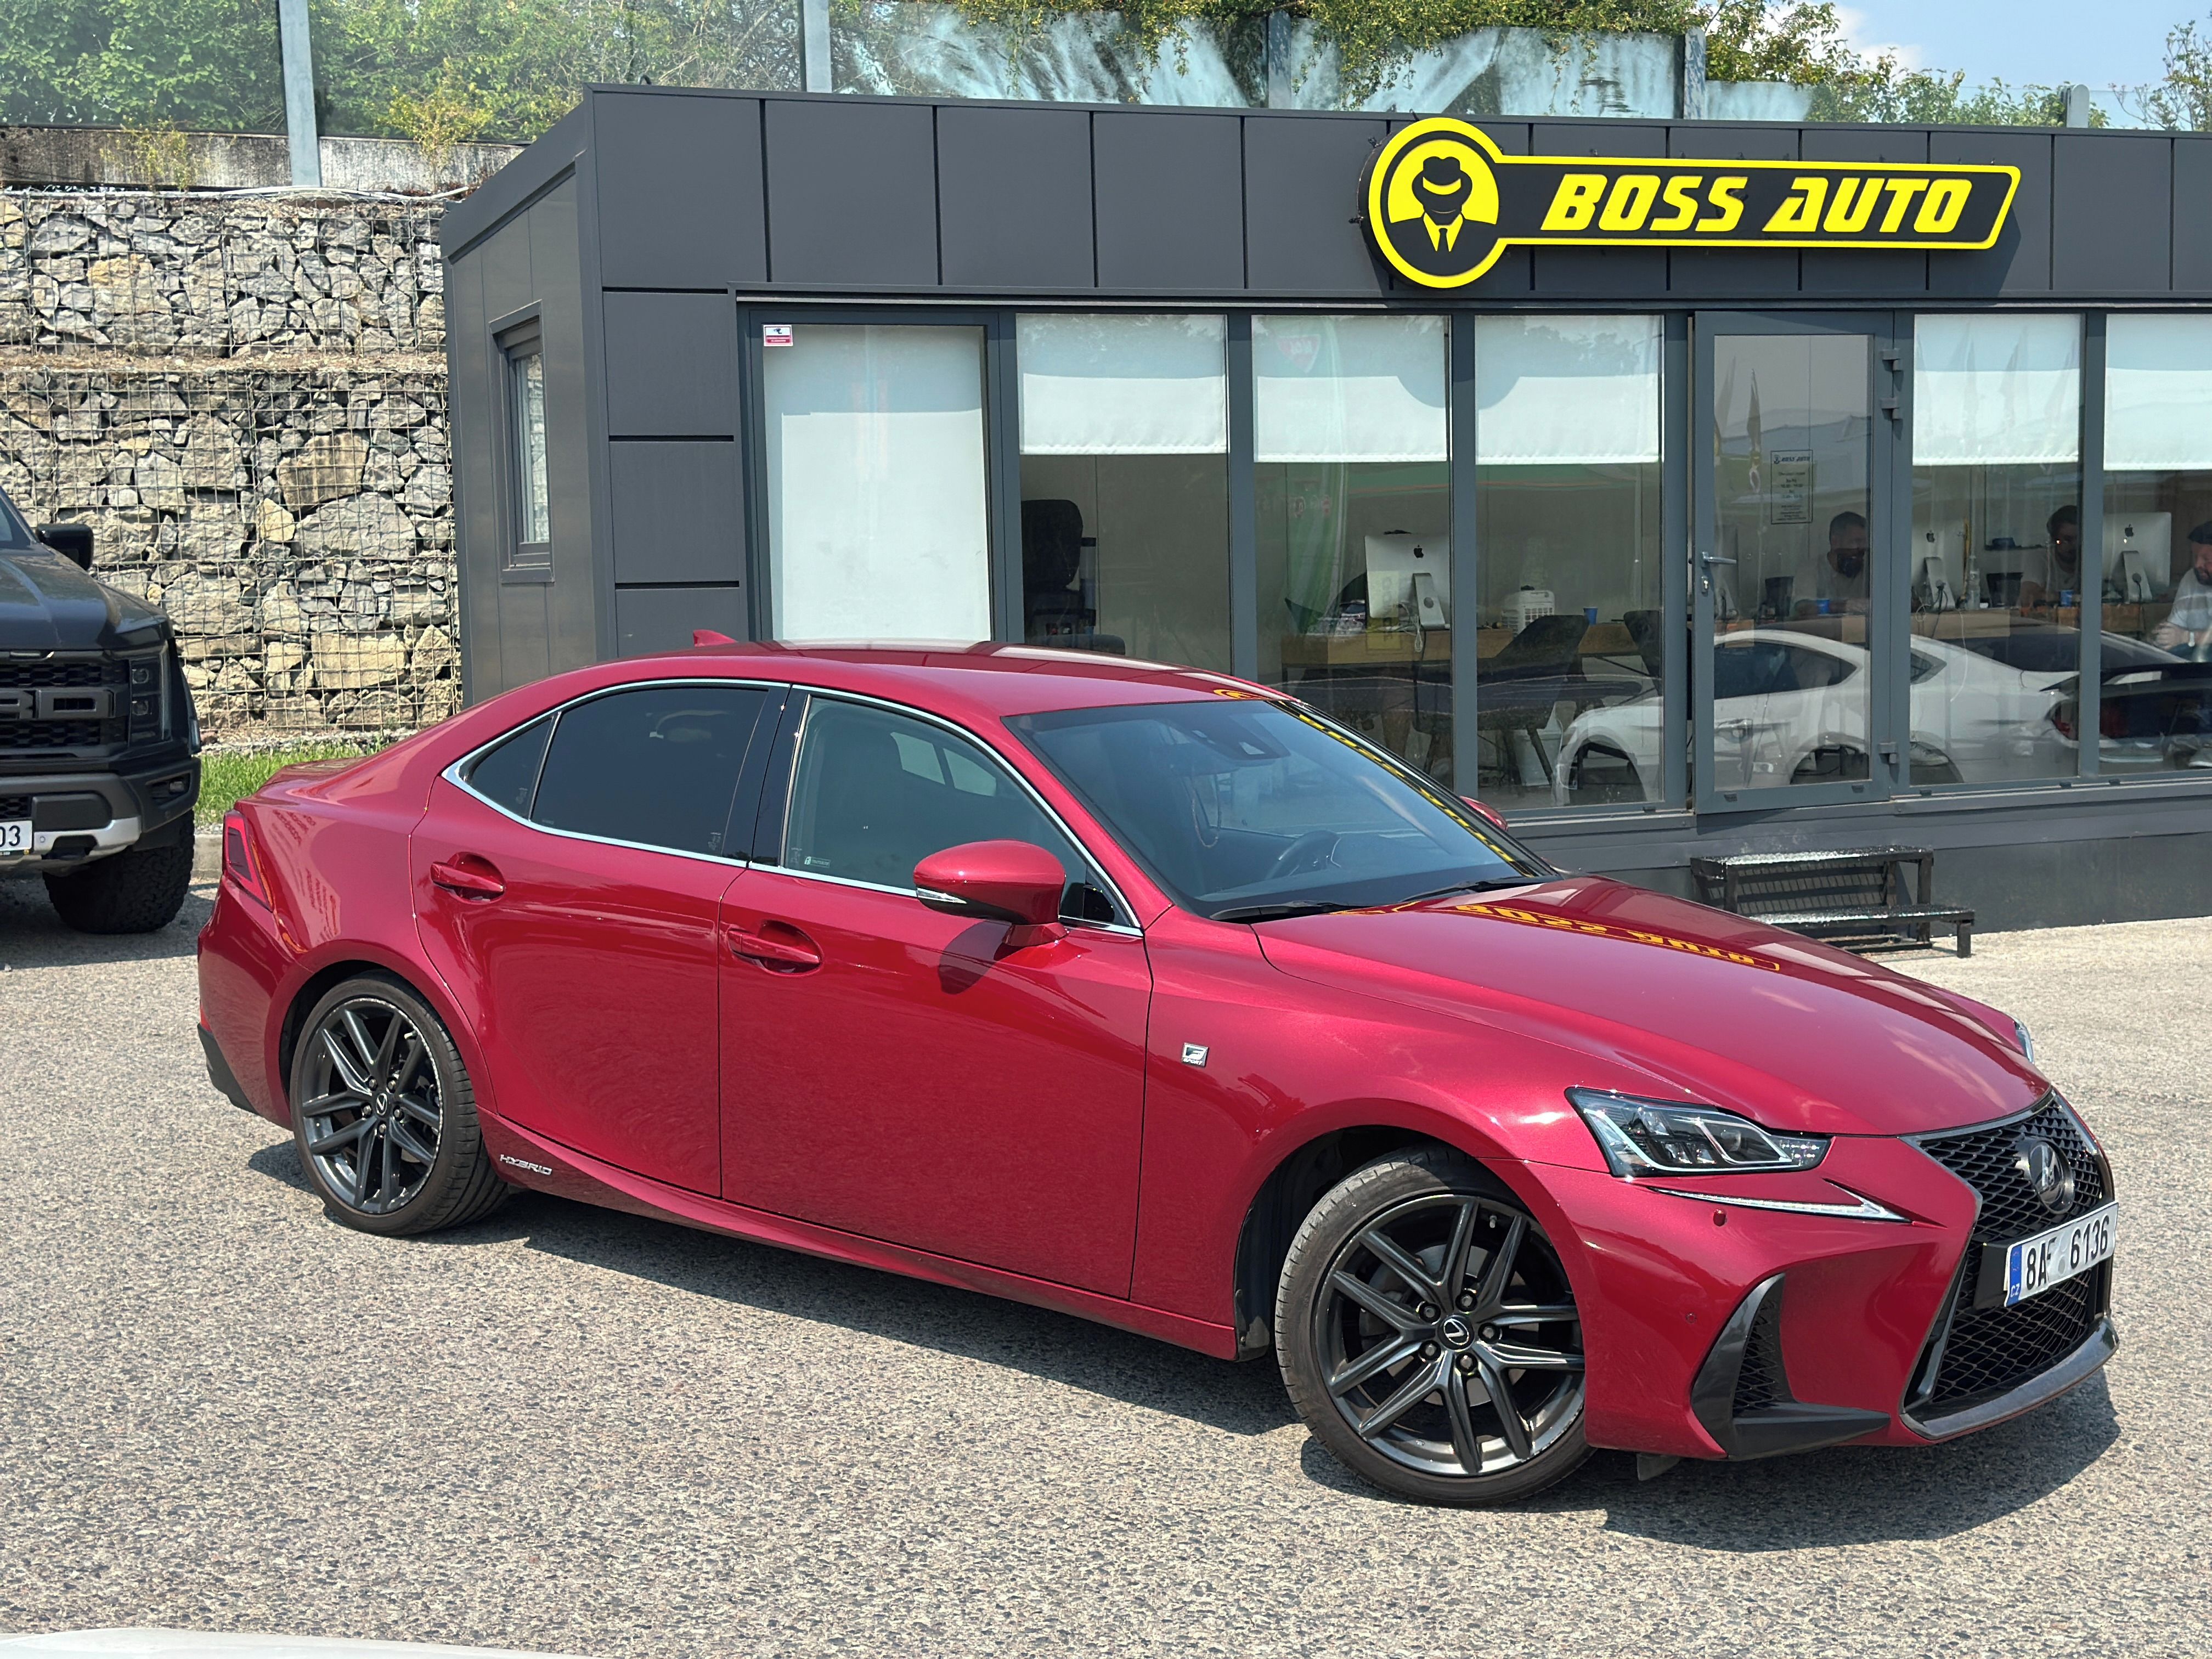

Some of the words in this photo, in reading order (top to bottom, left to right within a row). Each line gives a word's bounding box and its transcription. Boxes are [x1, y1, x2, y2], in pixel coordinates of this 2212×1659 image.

[1541, 173, 1748, 232] BOSS
[1762, 177, 1972, 233] AUTO
[500, 1154, 552, 1176] HYBRID
[2070, 1214, 2110, 1270] 6136
[2010, 1283, 2020, 1298] CZ
